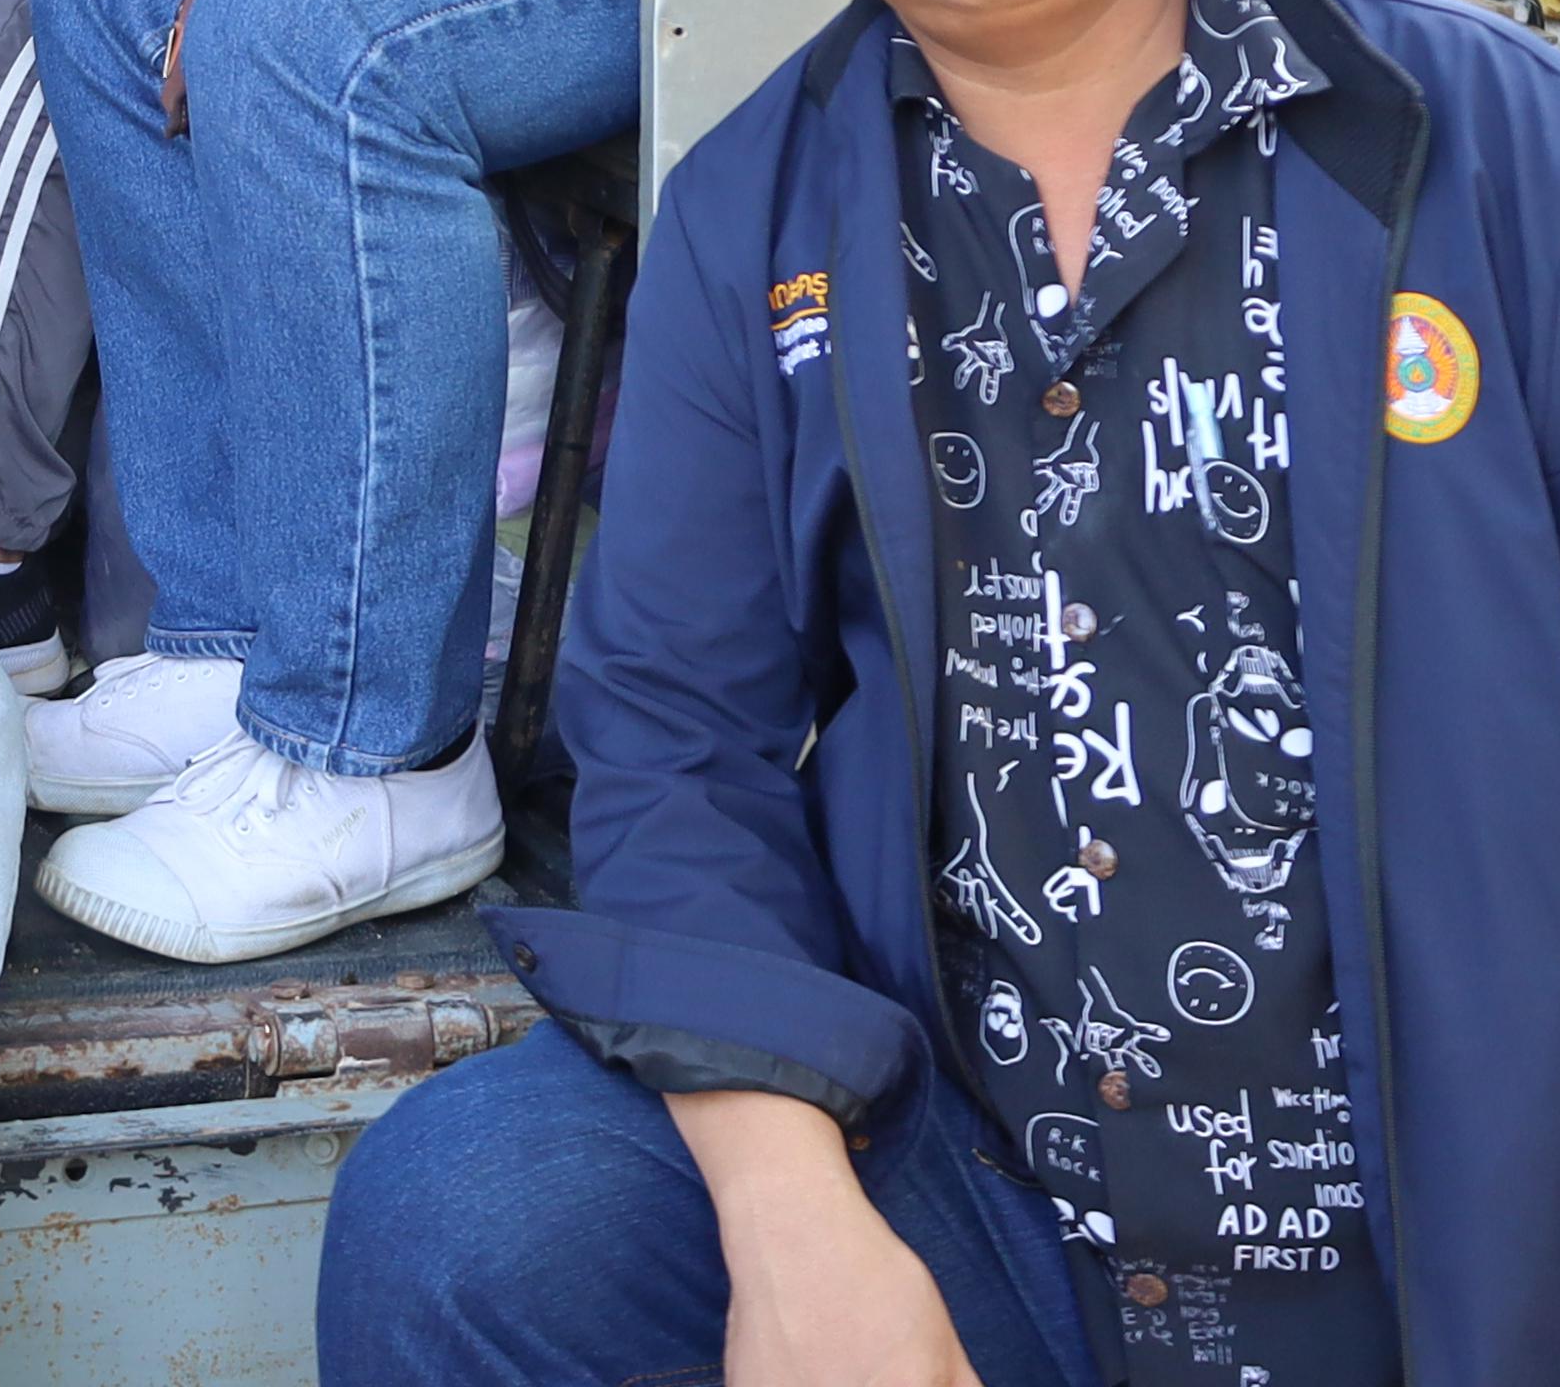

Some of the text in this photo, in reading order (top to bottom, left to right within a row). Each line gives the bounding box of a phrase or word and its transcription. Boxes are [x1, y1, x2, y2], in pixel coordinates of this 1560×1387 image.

[1166, 1088, 1254, 1144] used
[1195, 1138, 1258, 1195] for
[1217, 1203, 1332, 1239] AD AD
[1232, 1244, 1316, 1271] FIRST
